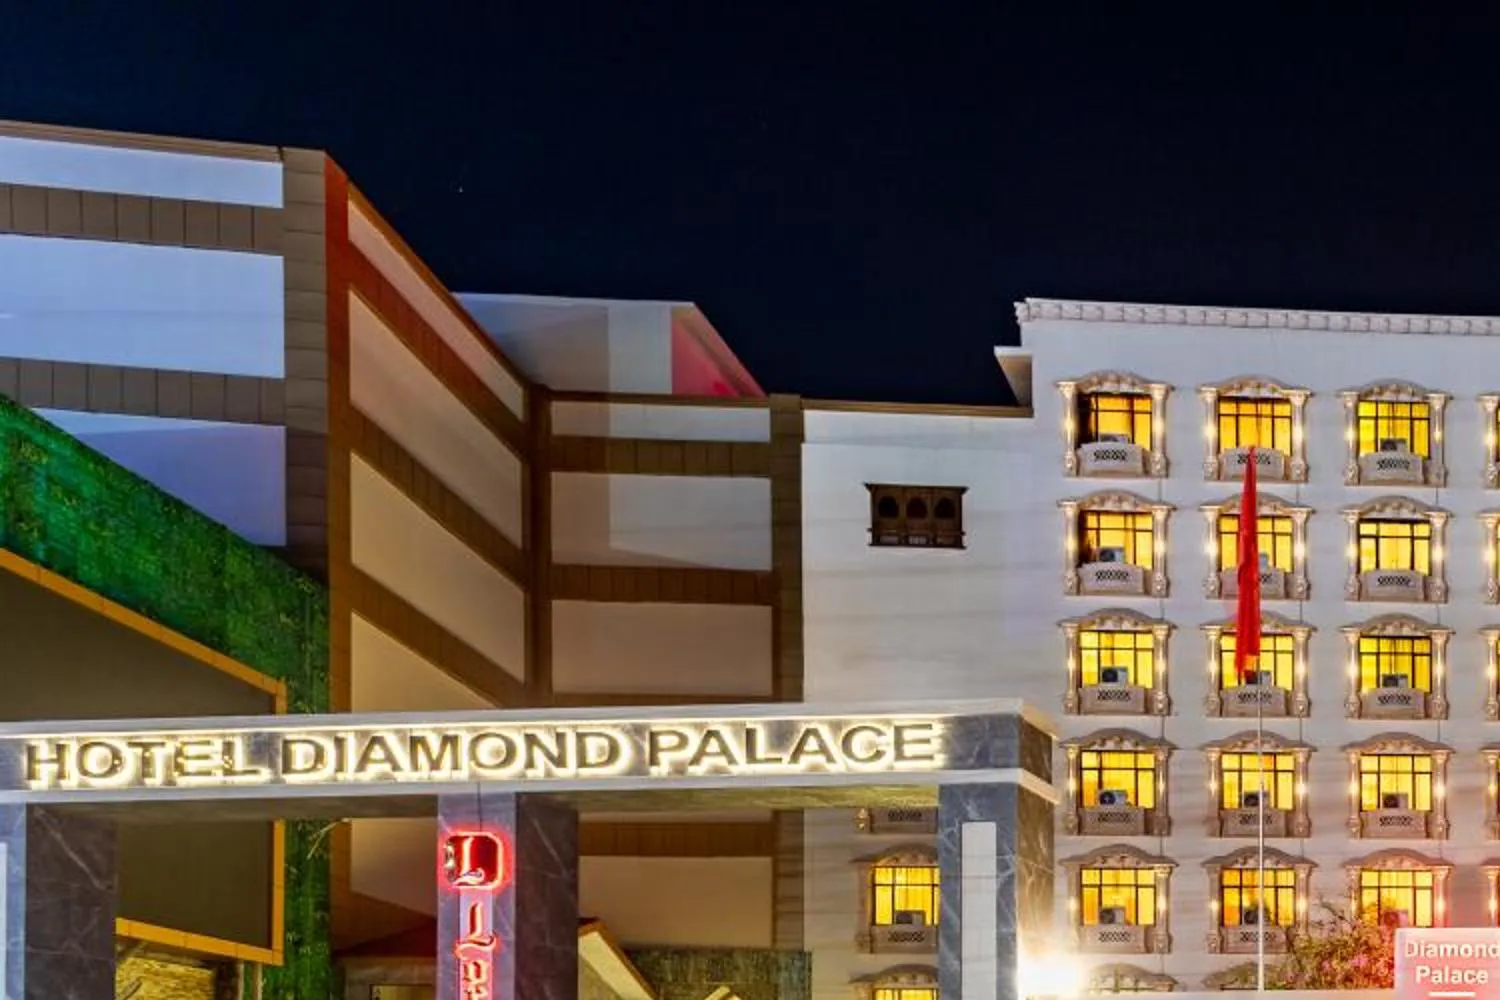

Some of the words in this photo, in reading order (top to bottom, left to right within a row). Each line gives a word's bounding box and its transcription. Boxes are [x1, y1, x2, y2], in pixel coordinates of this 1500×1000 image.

[25, 738, 266, 781] HOTEL
[281, 731, 620, 776] DIAMOND
[648, 722, 934, 768] PALACE
[1415, 965, 1489, 986] Palace
